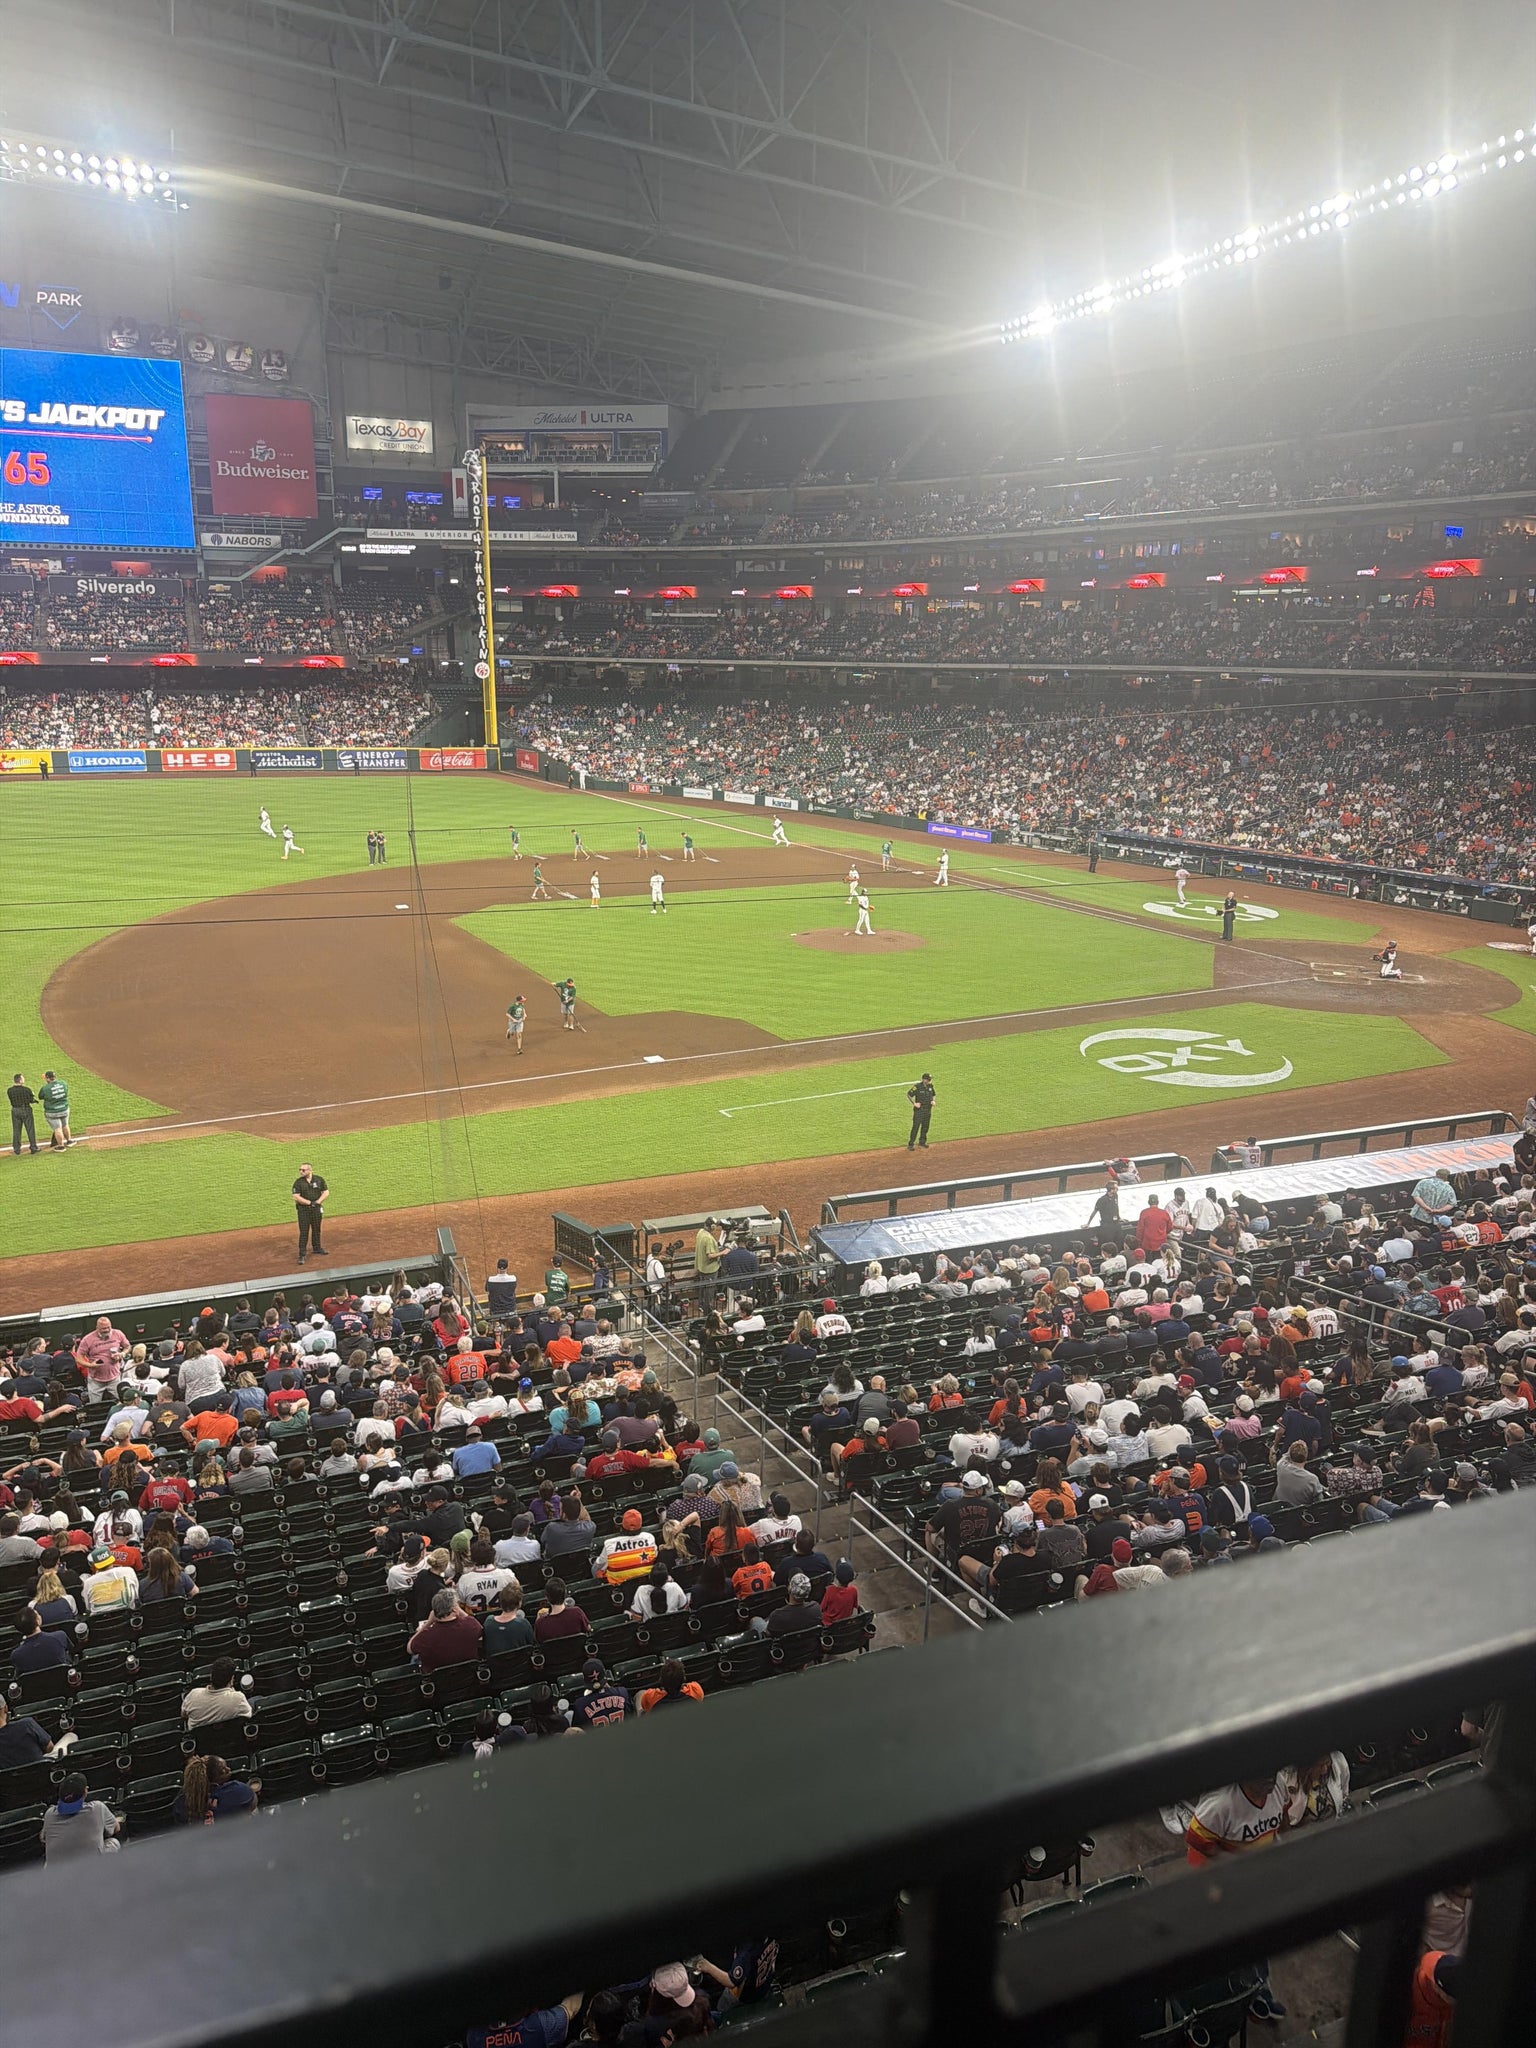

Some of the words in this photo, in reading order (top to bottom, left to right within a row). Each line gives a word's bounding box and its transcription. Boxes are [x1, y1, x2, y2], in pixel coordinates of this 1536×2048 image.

[37, 291, 83, 307] PARK
[28, 402, 165, 430] JACKPOT
[534, 412, 577, 425] Michelob
[590, 413, 634, 422] ULTRA
[352, 418, 393, 437] Texas
[398, 421, 426, 443] Bay
[380, 441, 401, 449] CREDIT
[216, 460, 309, 480] Budweiser
[18, 504, 61, 515] ASTROS
[471, 481, 481, 527] ROOT
[226, 536, 272, 546] NABORS
[474, 550, 485, 586] THA
[77, 579, 156, 595] Silverado
[476, 591, 489, 660] CHIKIN
[85, 757, 144, 766] HONDA
[257, 754, 317, 767] Methodist
[358, 758, 406, 767] TRANSFER
[1097, 1039, 1256, 1073] OXY
[887, 1218, 961, 1235] CHASE
[1465, 1233, 1478, 1243] 27
[1166, 1266, 1176, 1279] 11
[1320, 1324, 1334, 1337] 10
[460, 1365, 478, 1380] 28
[970, 1444, 989, 1454] PEÑA
[1186, 1512, 1202, 1531] 3
[960, 1518, 990, 1541] 27
[615, 1537, 649, 1551] Astros
[476, 1580, 498, 1592] RYAN
[584, 1696, 626, 1719] ALTUVE
[485, 2029, 523, 2048] PEÑA
